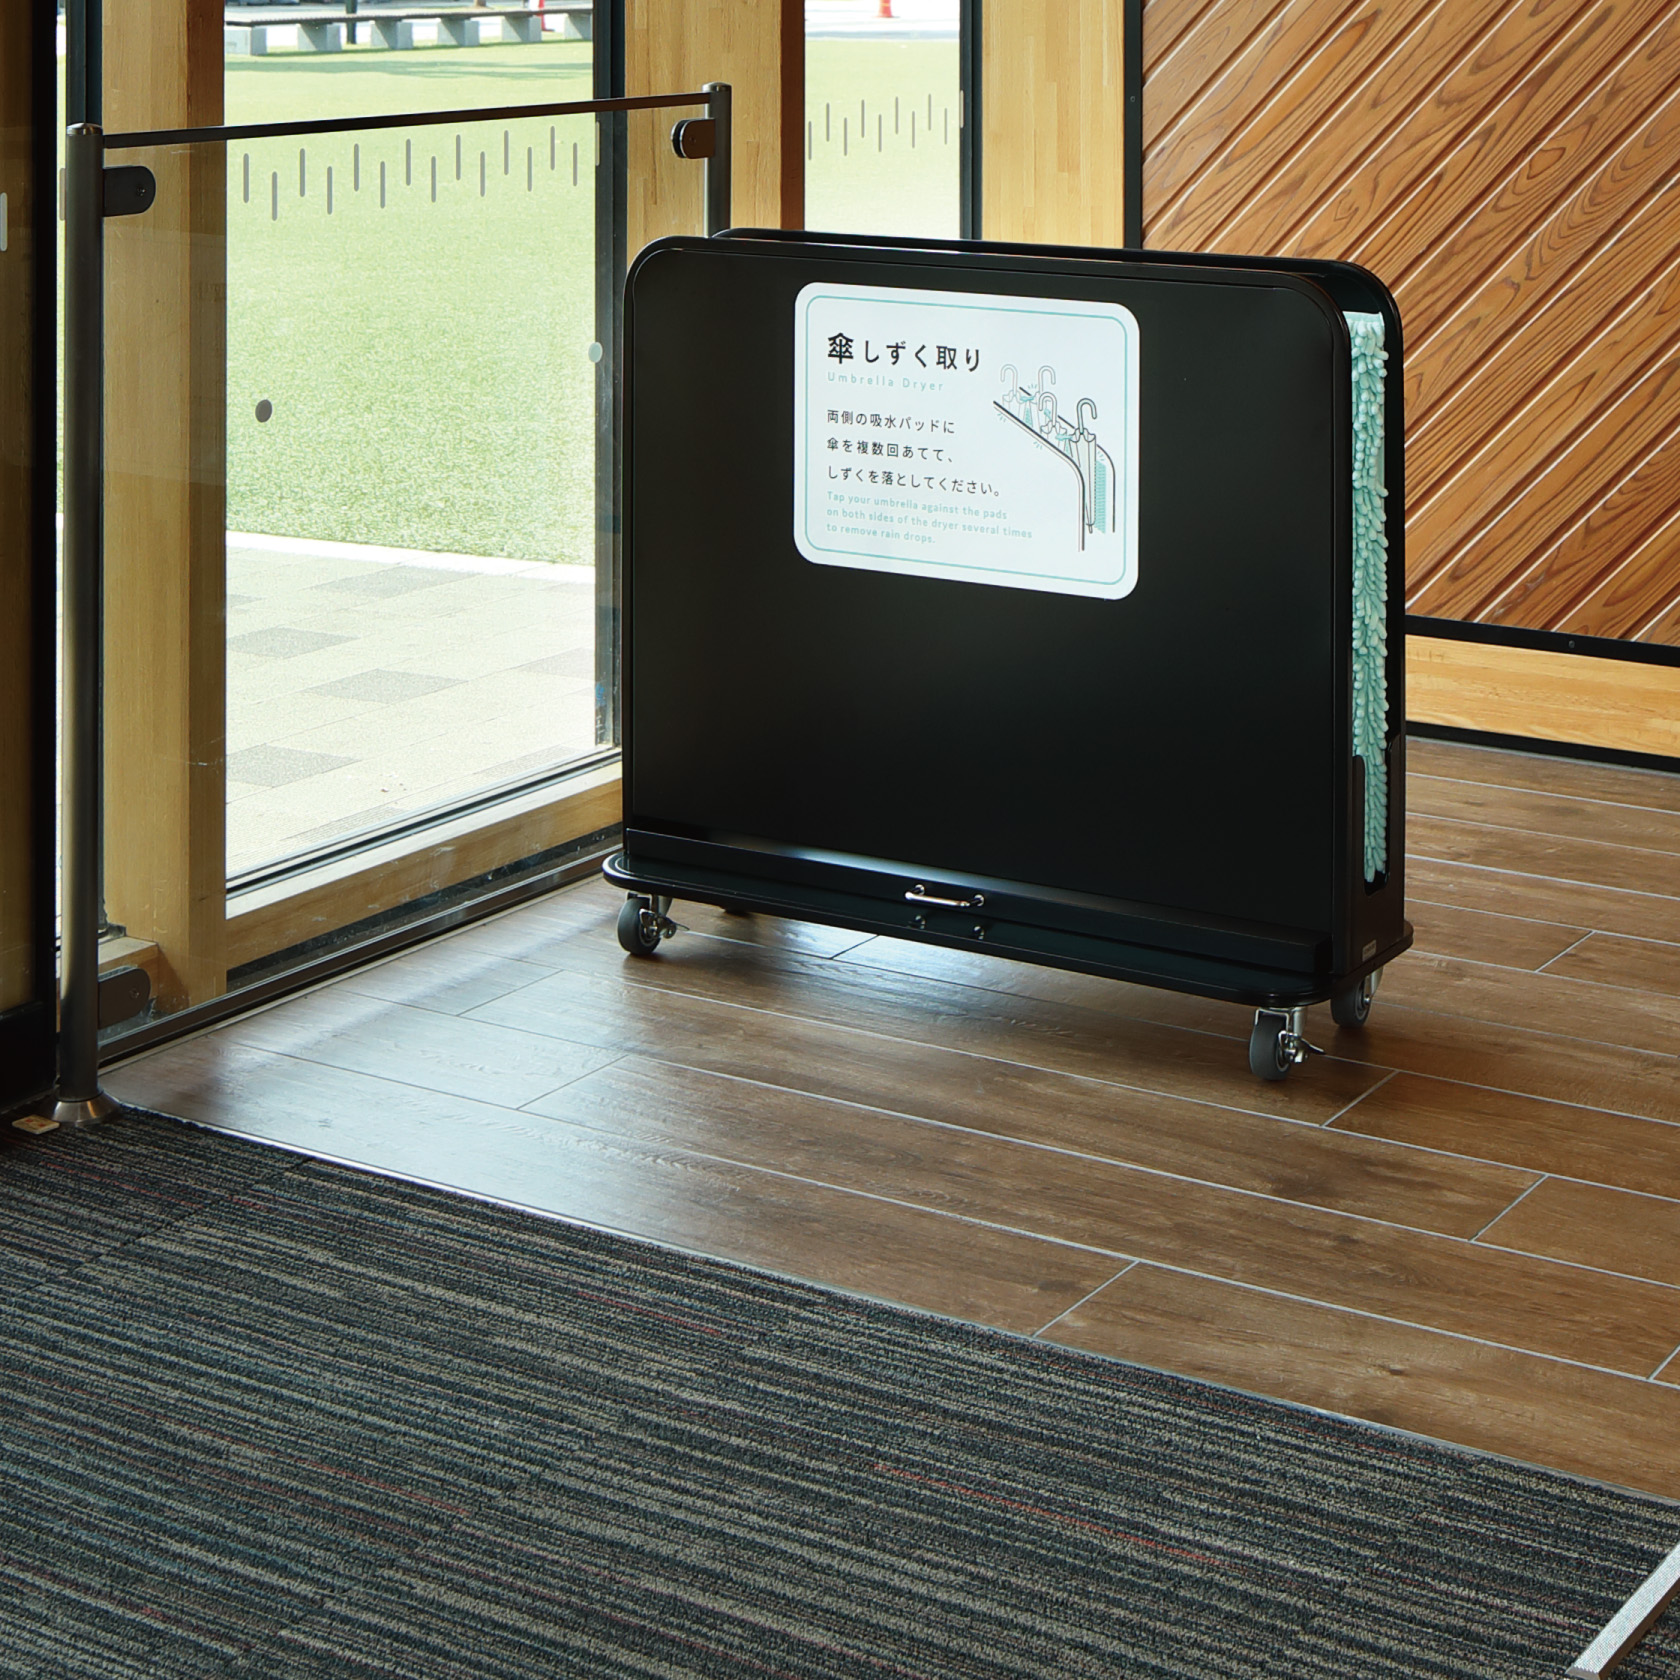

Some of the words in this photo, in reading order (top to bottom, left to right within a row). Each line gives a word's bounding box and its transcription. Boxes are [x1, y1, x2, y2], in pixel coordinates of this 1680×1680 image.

[826, 332, 982, 372] 傘しずく取り
[827, 372, 894, 387] Umbrella
[902, 377, 944, 392] Dryer
[827, 409, 955, 434] 両側の吸水パッドに
[827, 437, 953, 463] 傘を複数回あてて、
[828, 465, 1000, 497] しずくを落としてください。
[827, 491, 845, 503] Tap
[848, 494, 871, 506] your
[874, 496, 918, 510] umbrella
[922, 501, 959, 514] against
[962, 505, 980, 517] the
[983, 508, 1008, 521] pads
[826, 523, 838, 532] to
[840, 526, 878, 537] remove
[881, 528, 901, 540] rain
[904, 529, 936, 544] drops.
[827, 508, 839, 516] on
[842, 508, 866, 520] both
[869, 510, 894, 523] sides
[897, 514, 909, 524] of
[911, 515, 929, 527] the
[931, 517, 958, 531] dryer
[962, 521, 1000, 535] several
[1003, 526, 1033, 539] times
